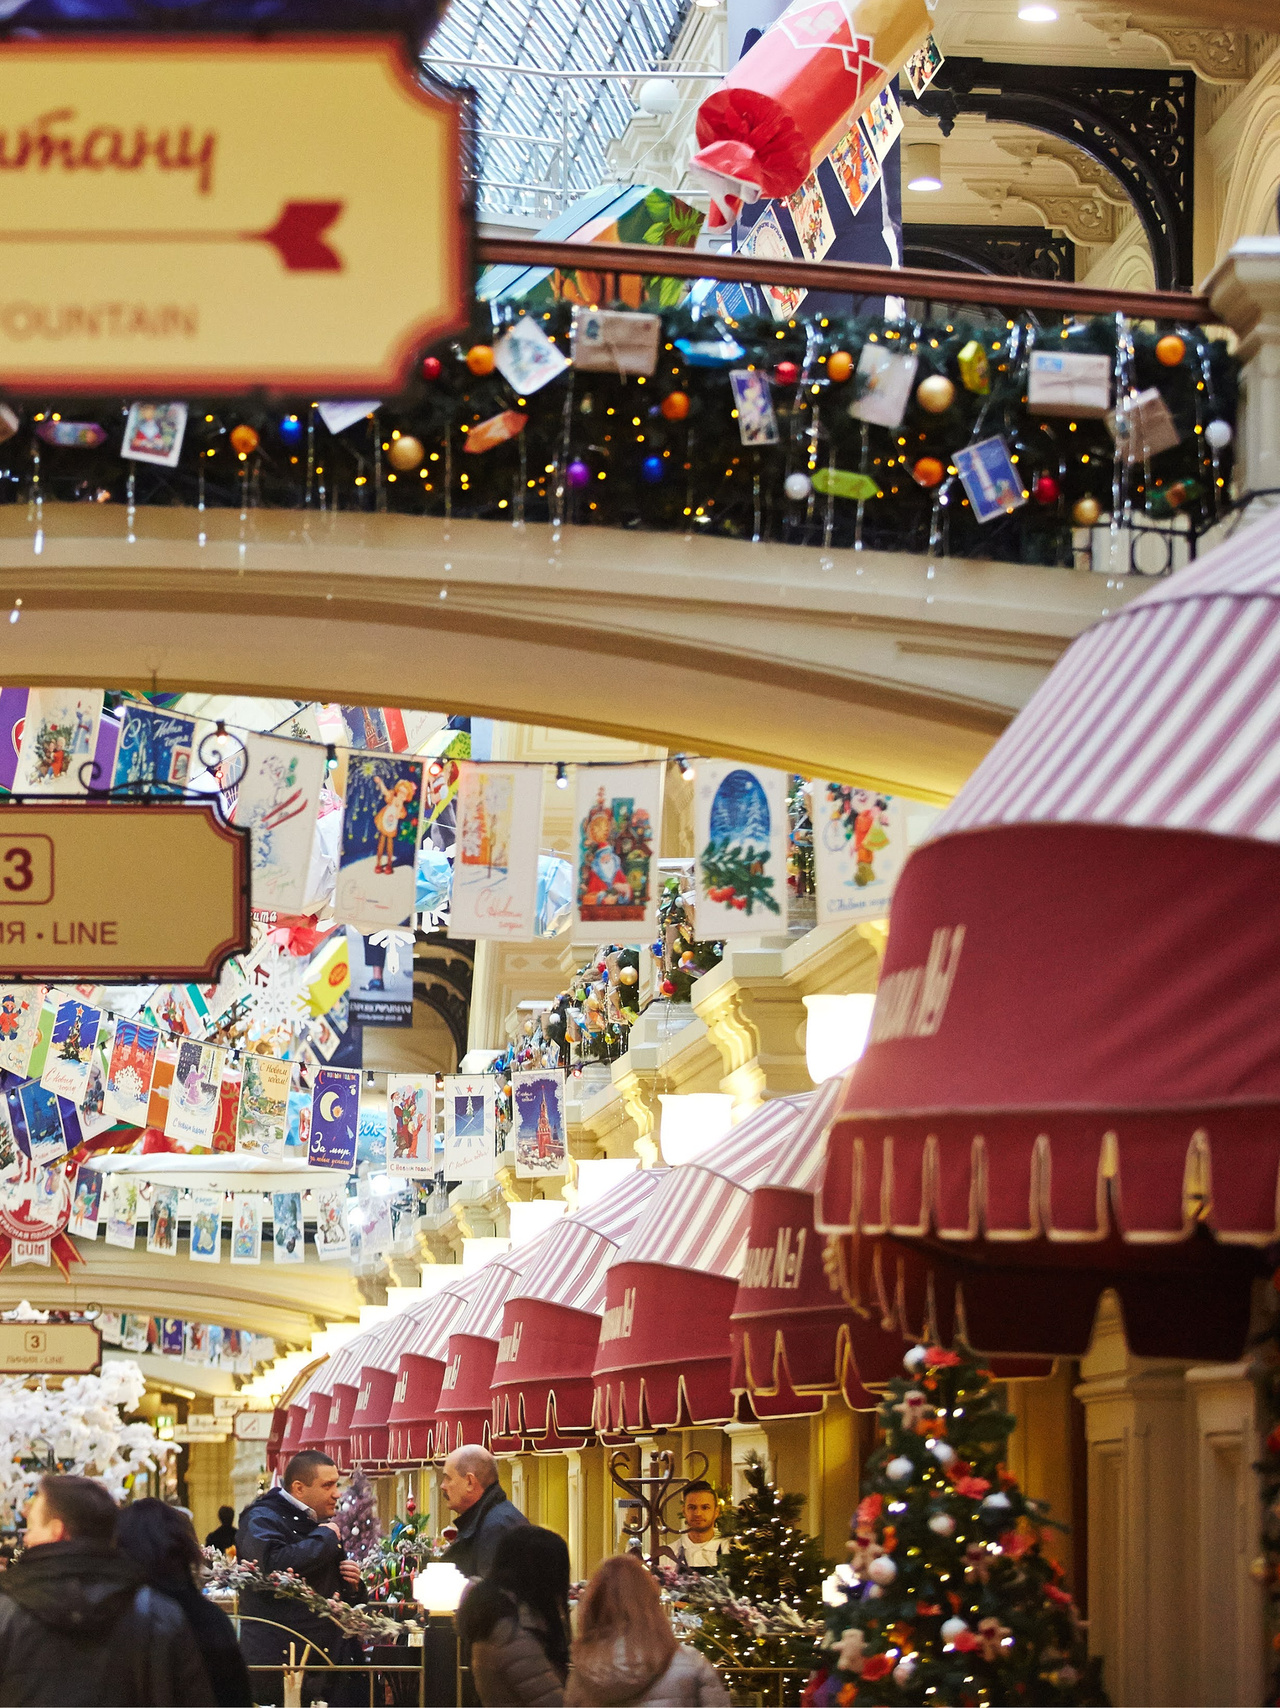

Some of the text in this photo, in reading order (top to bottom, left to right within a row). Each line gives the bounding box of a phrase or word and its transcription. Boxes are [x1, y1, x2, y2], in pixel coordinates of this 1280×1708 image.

[2, 847, 33, 892] 3
[53, 921, 119, 946] LINE
[311, 1131, 326, 1154] За
[17, 1243, 45, 1256] GUM
[30, 1335, 40, 1349] 3
